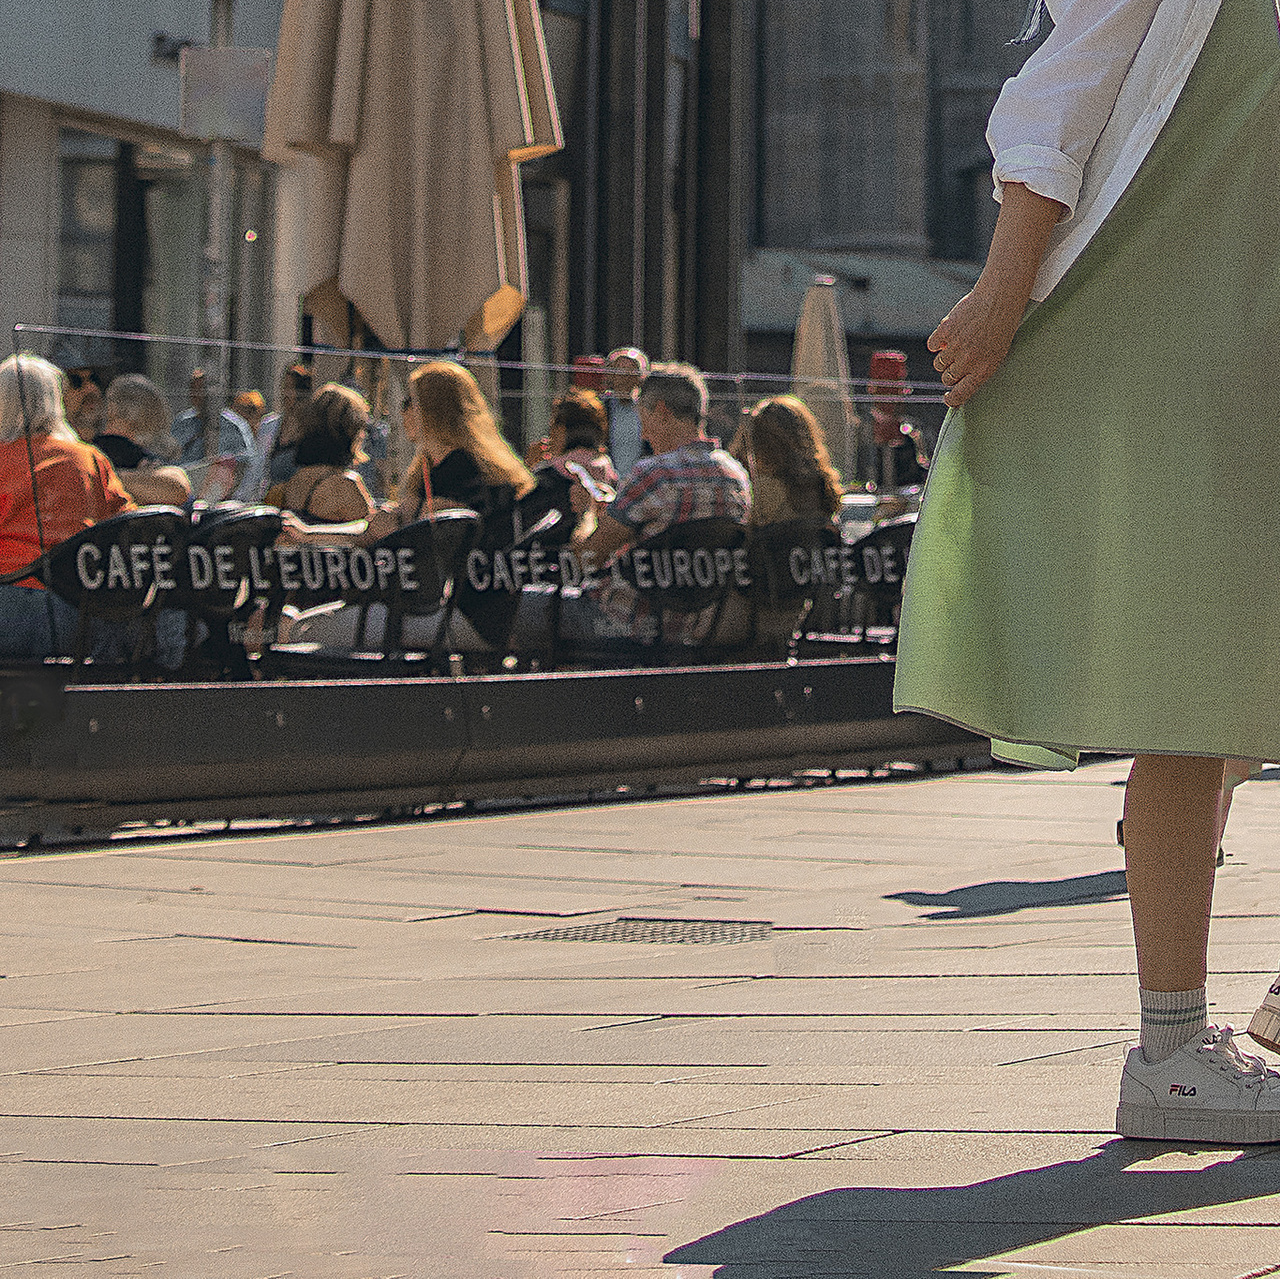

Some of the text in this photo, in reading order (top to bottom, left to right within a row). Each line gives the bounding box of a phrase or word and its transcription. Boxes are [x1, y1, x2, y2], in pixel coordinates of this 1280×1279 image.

[76, 534, 420, 591] CAFÉ DE L'EUROPE
[559, 548, 599, 589] DE
[864, 546, 898, 583] DE
[1169, 1084, 1196, 1096] FILA
